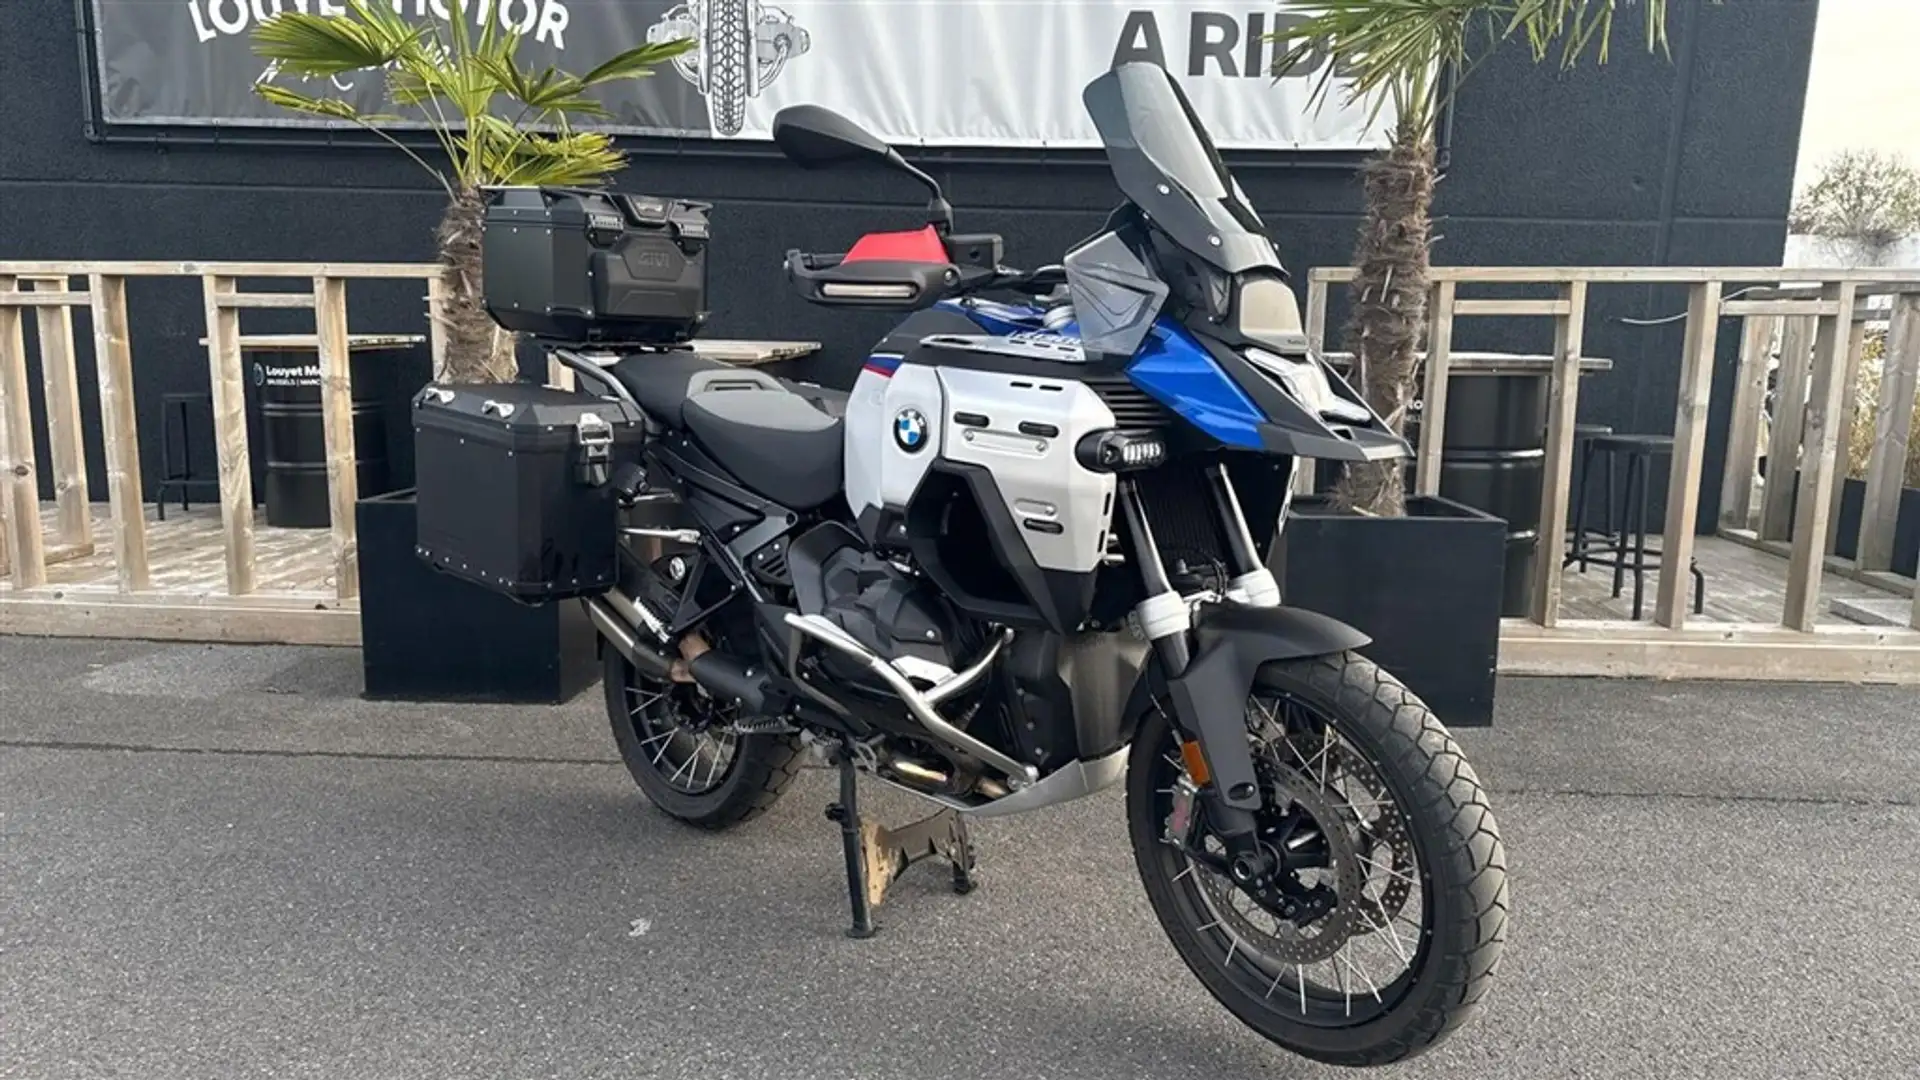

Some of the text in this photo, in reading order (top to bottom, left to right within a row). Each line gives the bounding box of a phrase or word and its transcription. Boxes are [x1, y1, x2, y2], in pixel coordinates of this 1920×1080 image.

[188, 0, 369, 43] LOU
[1110, 10, 1167, 71] A
[266, 366, 302, 377] Louyet
